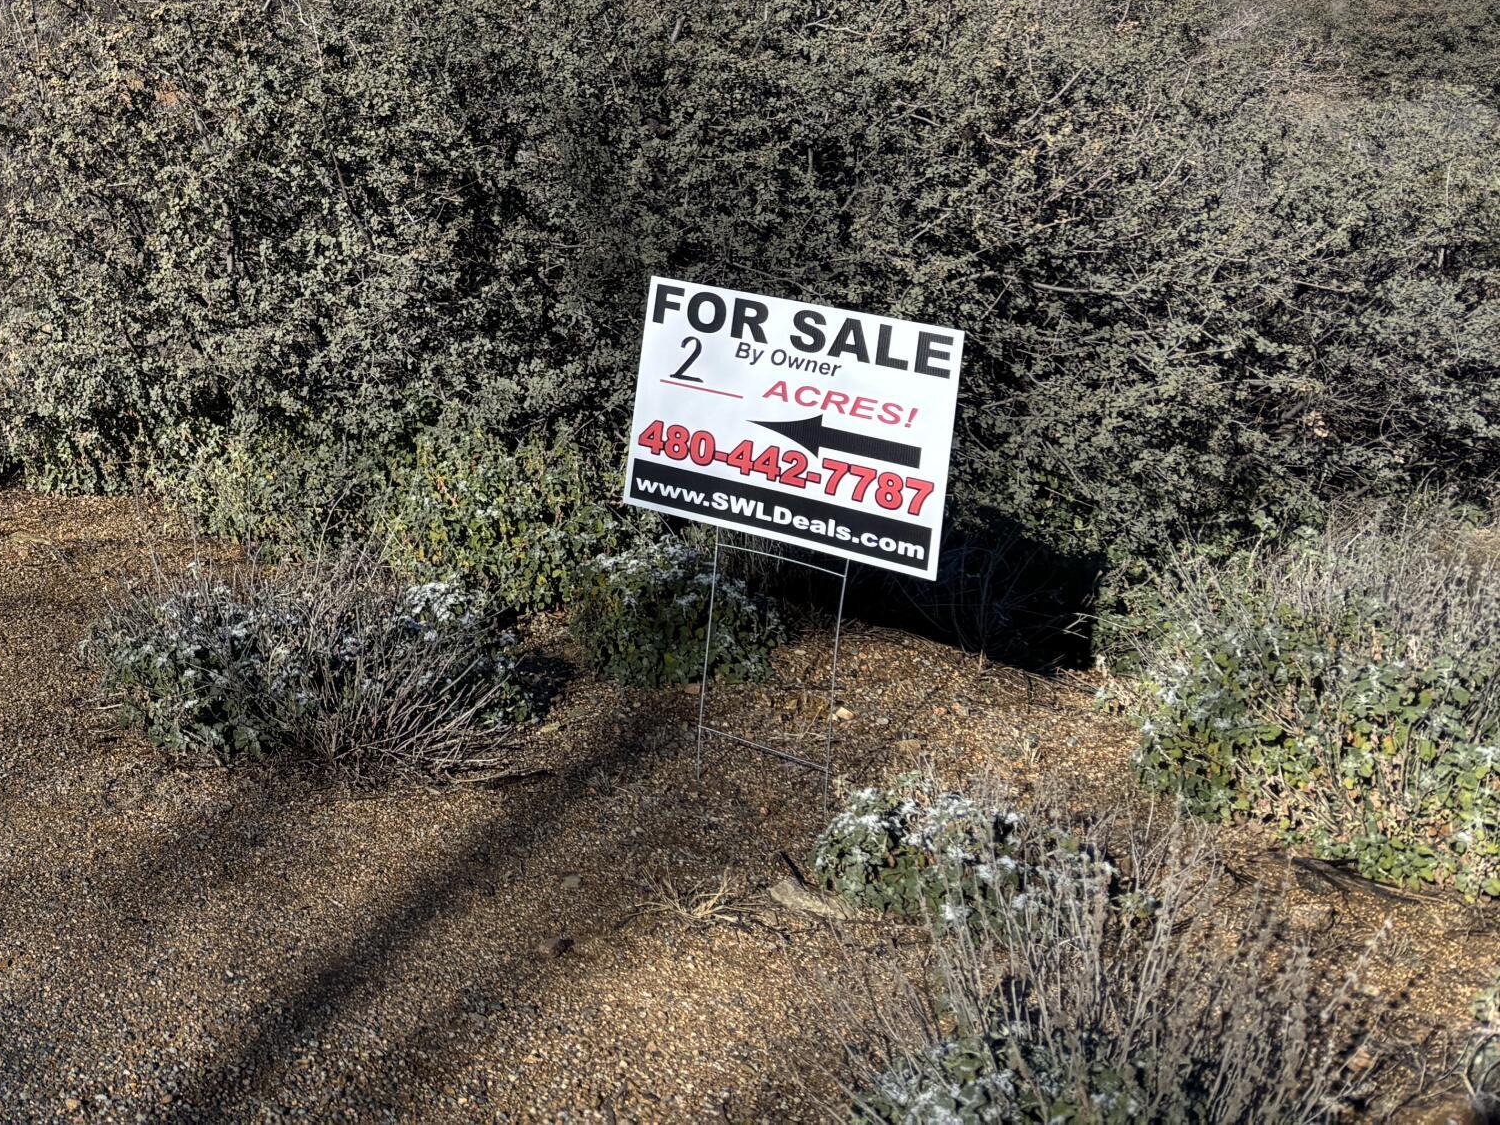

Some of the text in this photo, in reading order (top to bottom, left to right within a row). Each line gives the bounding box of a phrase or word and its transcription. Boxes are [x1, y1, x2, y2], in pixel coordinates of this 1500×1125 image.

[651, 283, 954, 379] FOR SALE
[669, 336, 704, 383] 2
[735, 342, 842, 377] By Owner
[762, 380, 919, 428] ACRES!
[638, 419, 935, 516] 480-442-7787
[635, 477, 926, 560] www.SWLDeals.com
